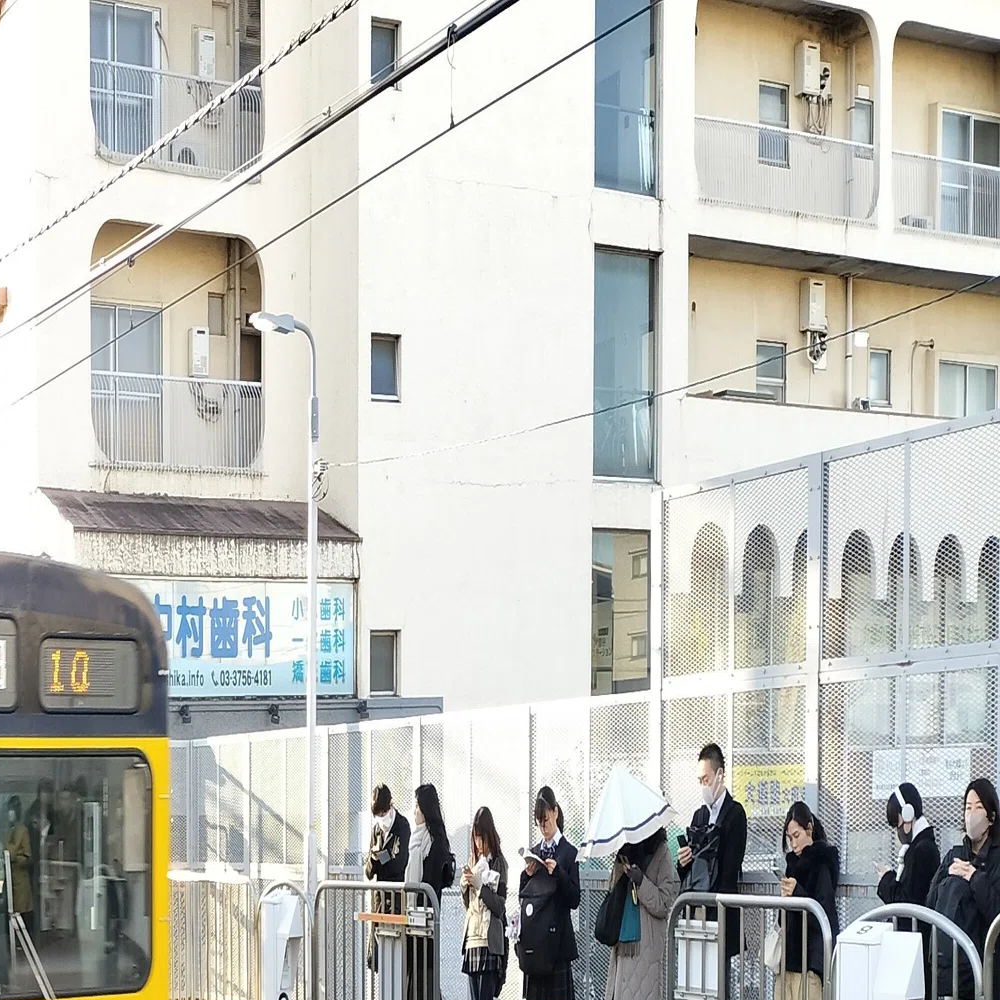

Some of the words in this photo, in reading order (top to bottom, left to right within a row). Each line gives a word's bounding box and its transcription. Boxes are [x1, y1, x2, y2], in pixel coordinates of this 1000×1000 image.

[292, 597, 345, 621] 小歯科
[292, 628, 345, 653] 一歯科
[49, 649, 91, 693] 10
[220, 669, 272, 687] 03-3756-4181
[292, 660, 345, 684] 矯歯科
